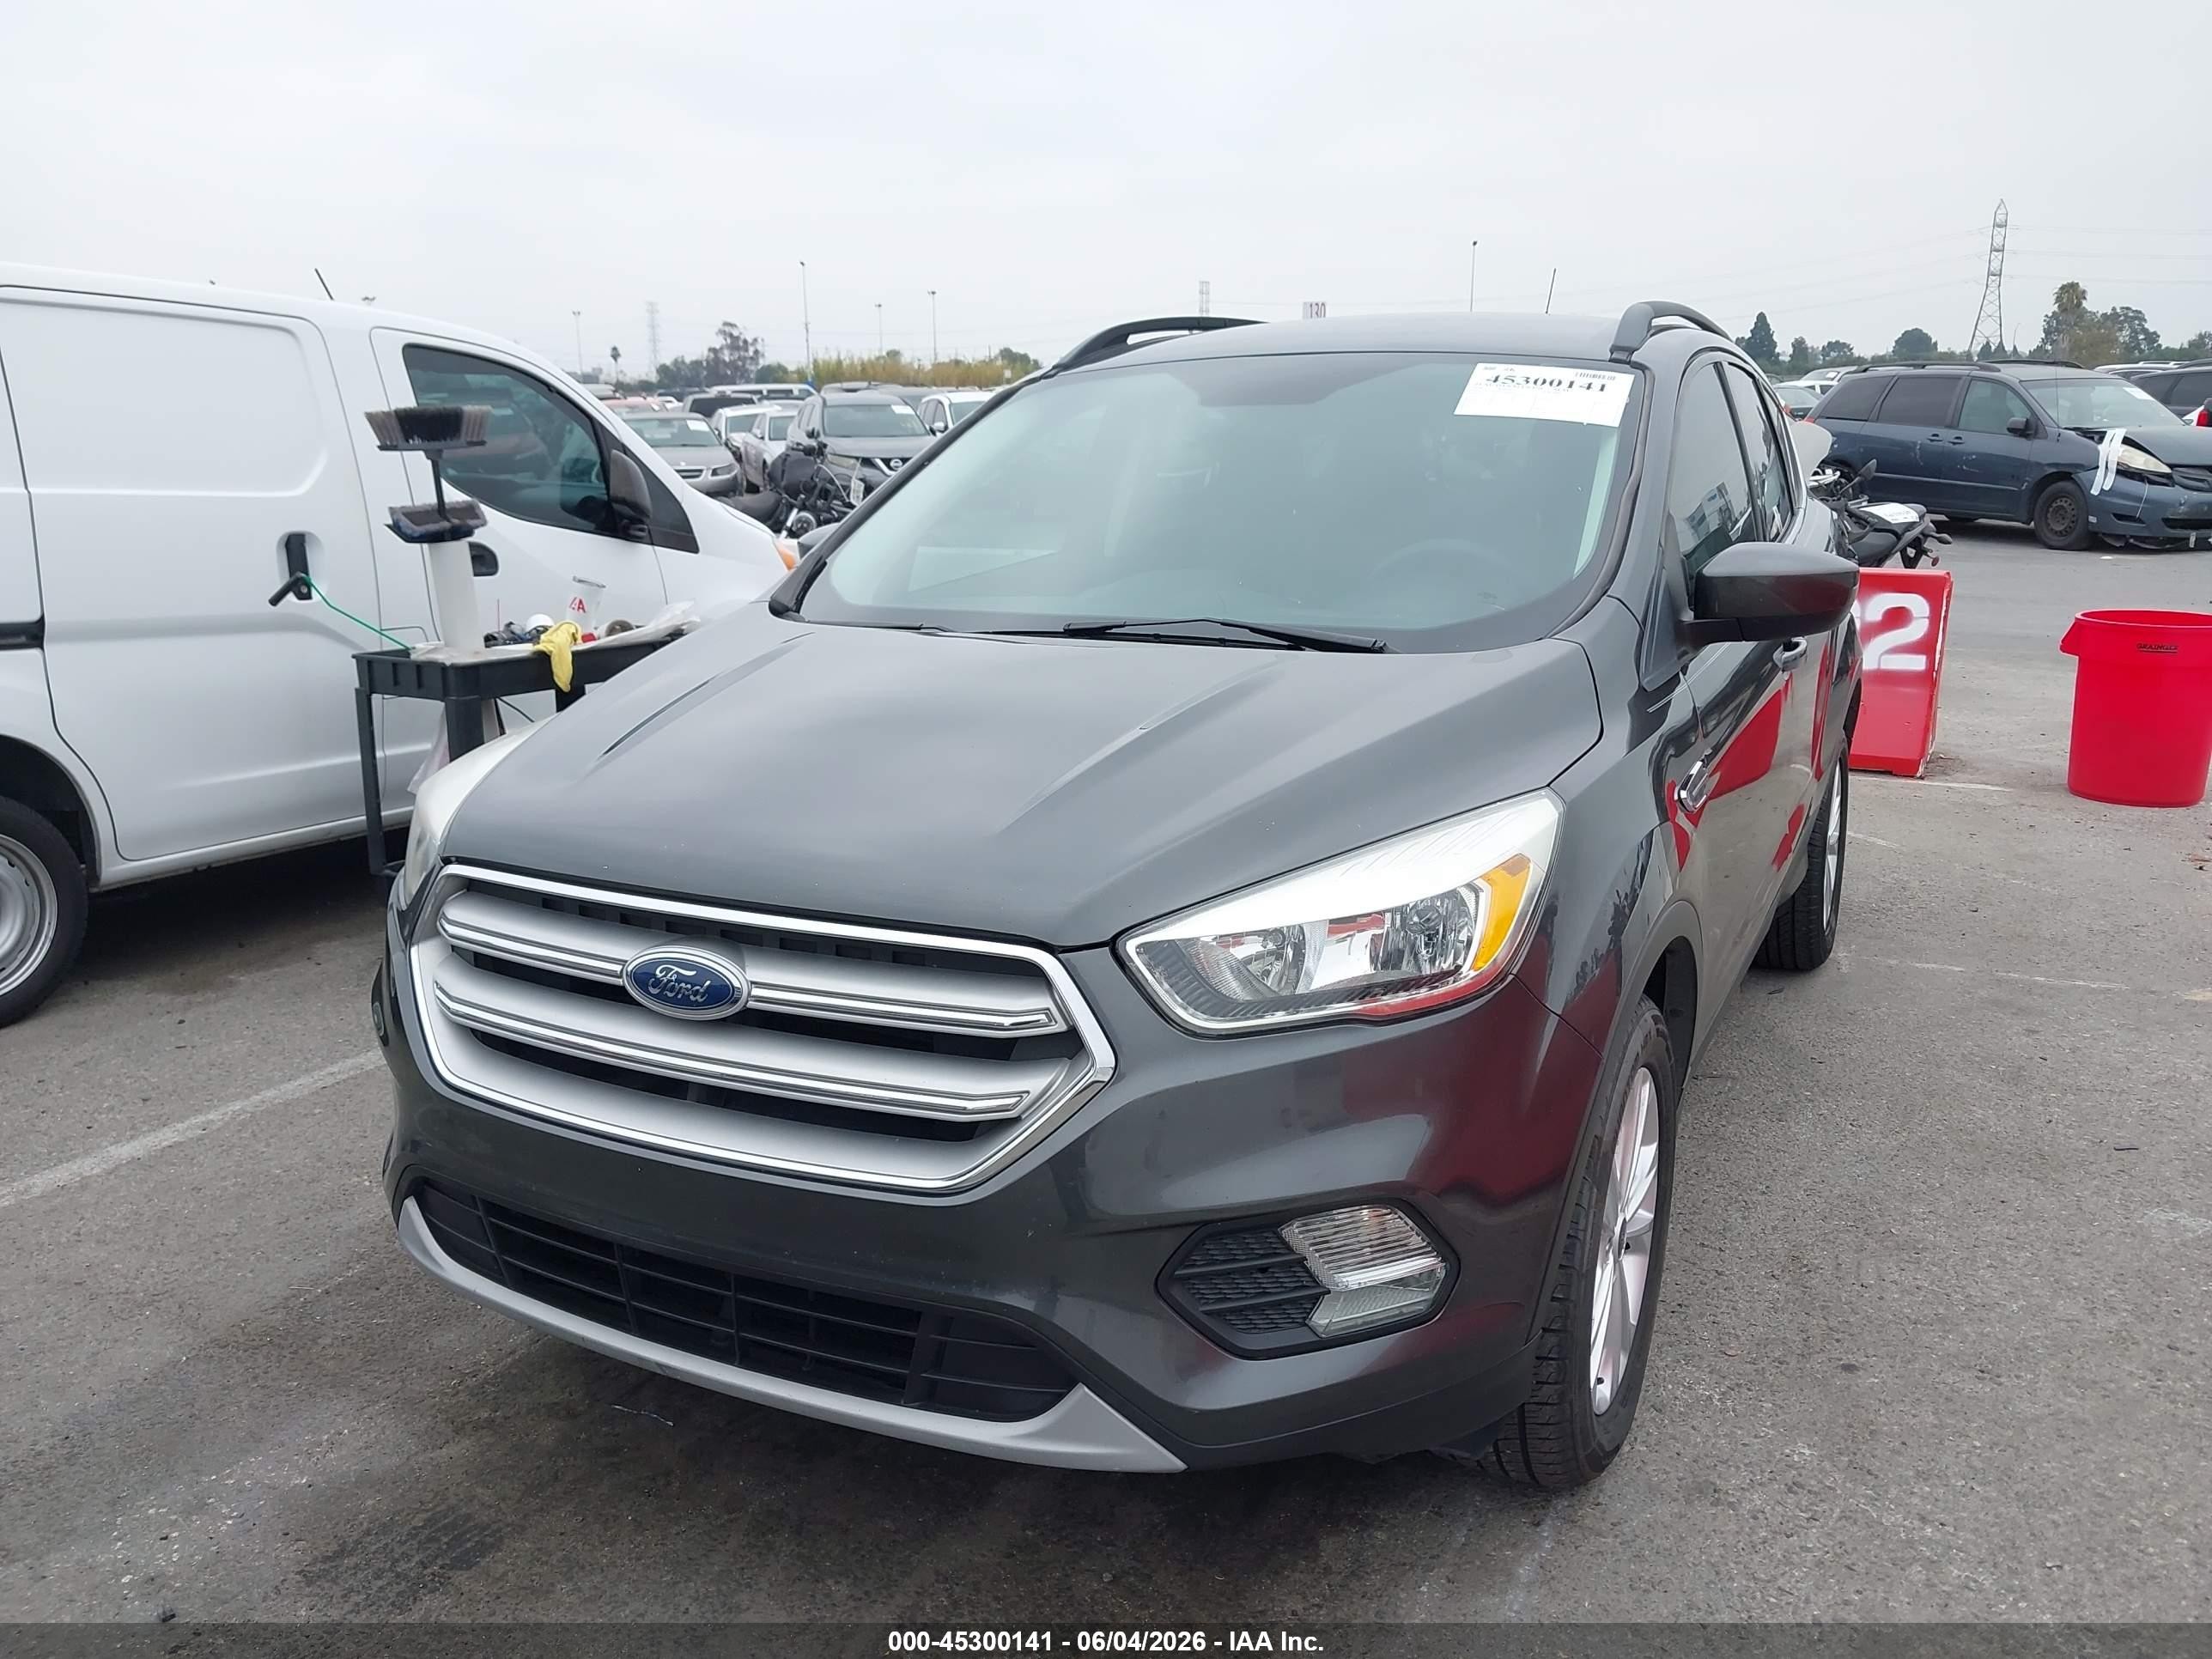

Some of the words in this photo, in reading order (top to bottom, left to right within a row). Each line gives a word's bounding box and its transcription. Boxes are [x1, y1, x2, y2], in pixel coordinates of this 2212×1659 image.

[1486, 374, 1607, 392] 45300141
[1850, 592, 1929, 670] 2
[647, 964, 712, 1003] Ford
